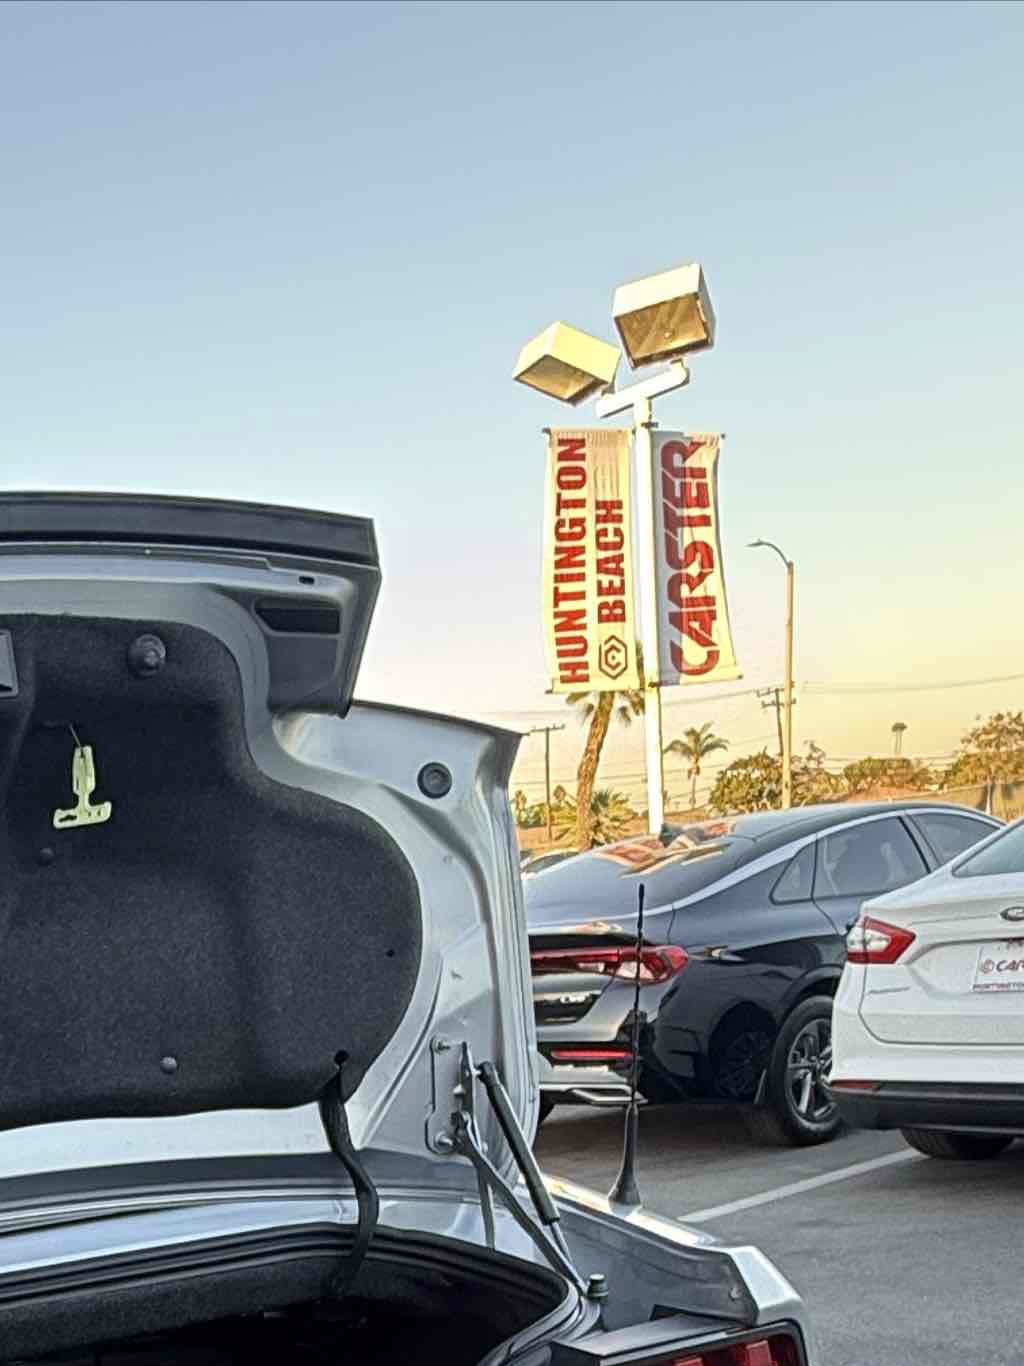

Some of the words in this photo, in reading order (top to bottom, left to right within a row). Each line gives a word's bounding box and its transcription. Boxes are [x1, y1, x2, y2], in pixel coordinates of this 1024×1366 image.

[553, 437, 590, 684] HUNTINGTON
[595, 499, 627, 624] BEACH
[660, 440, 720, 677] CARSTER
